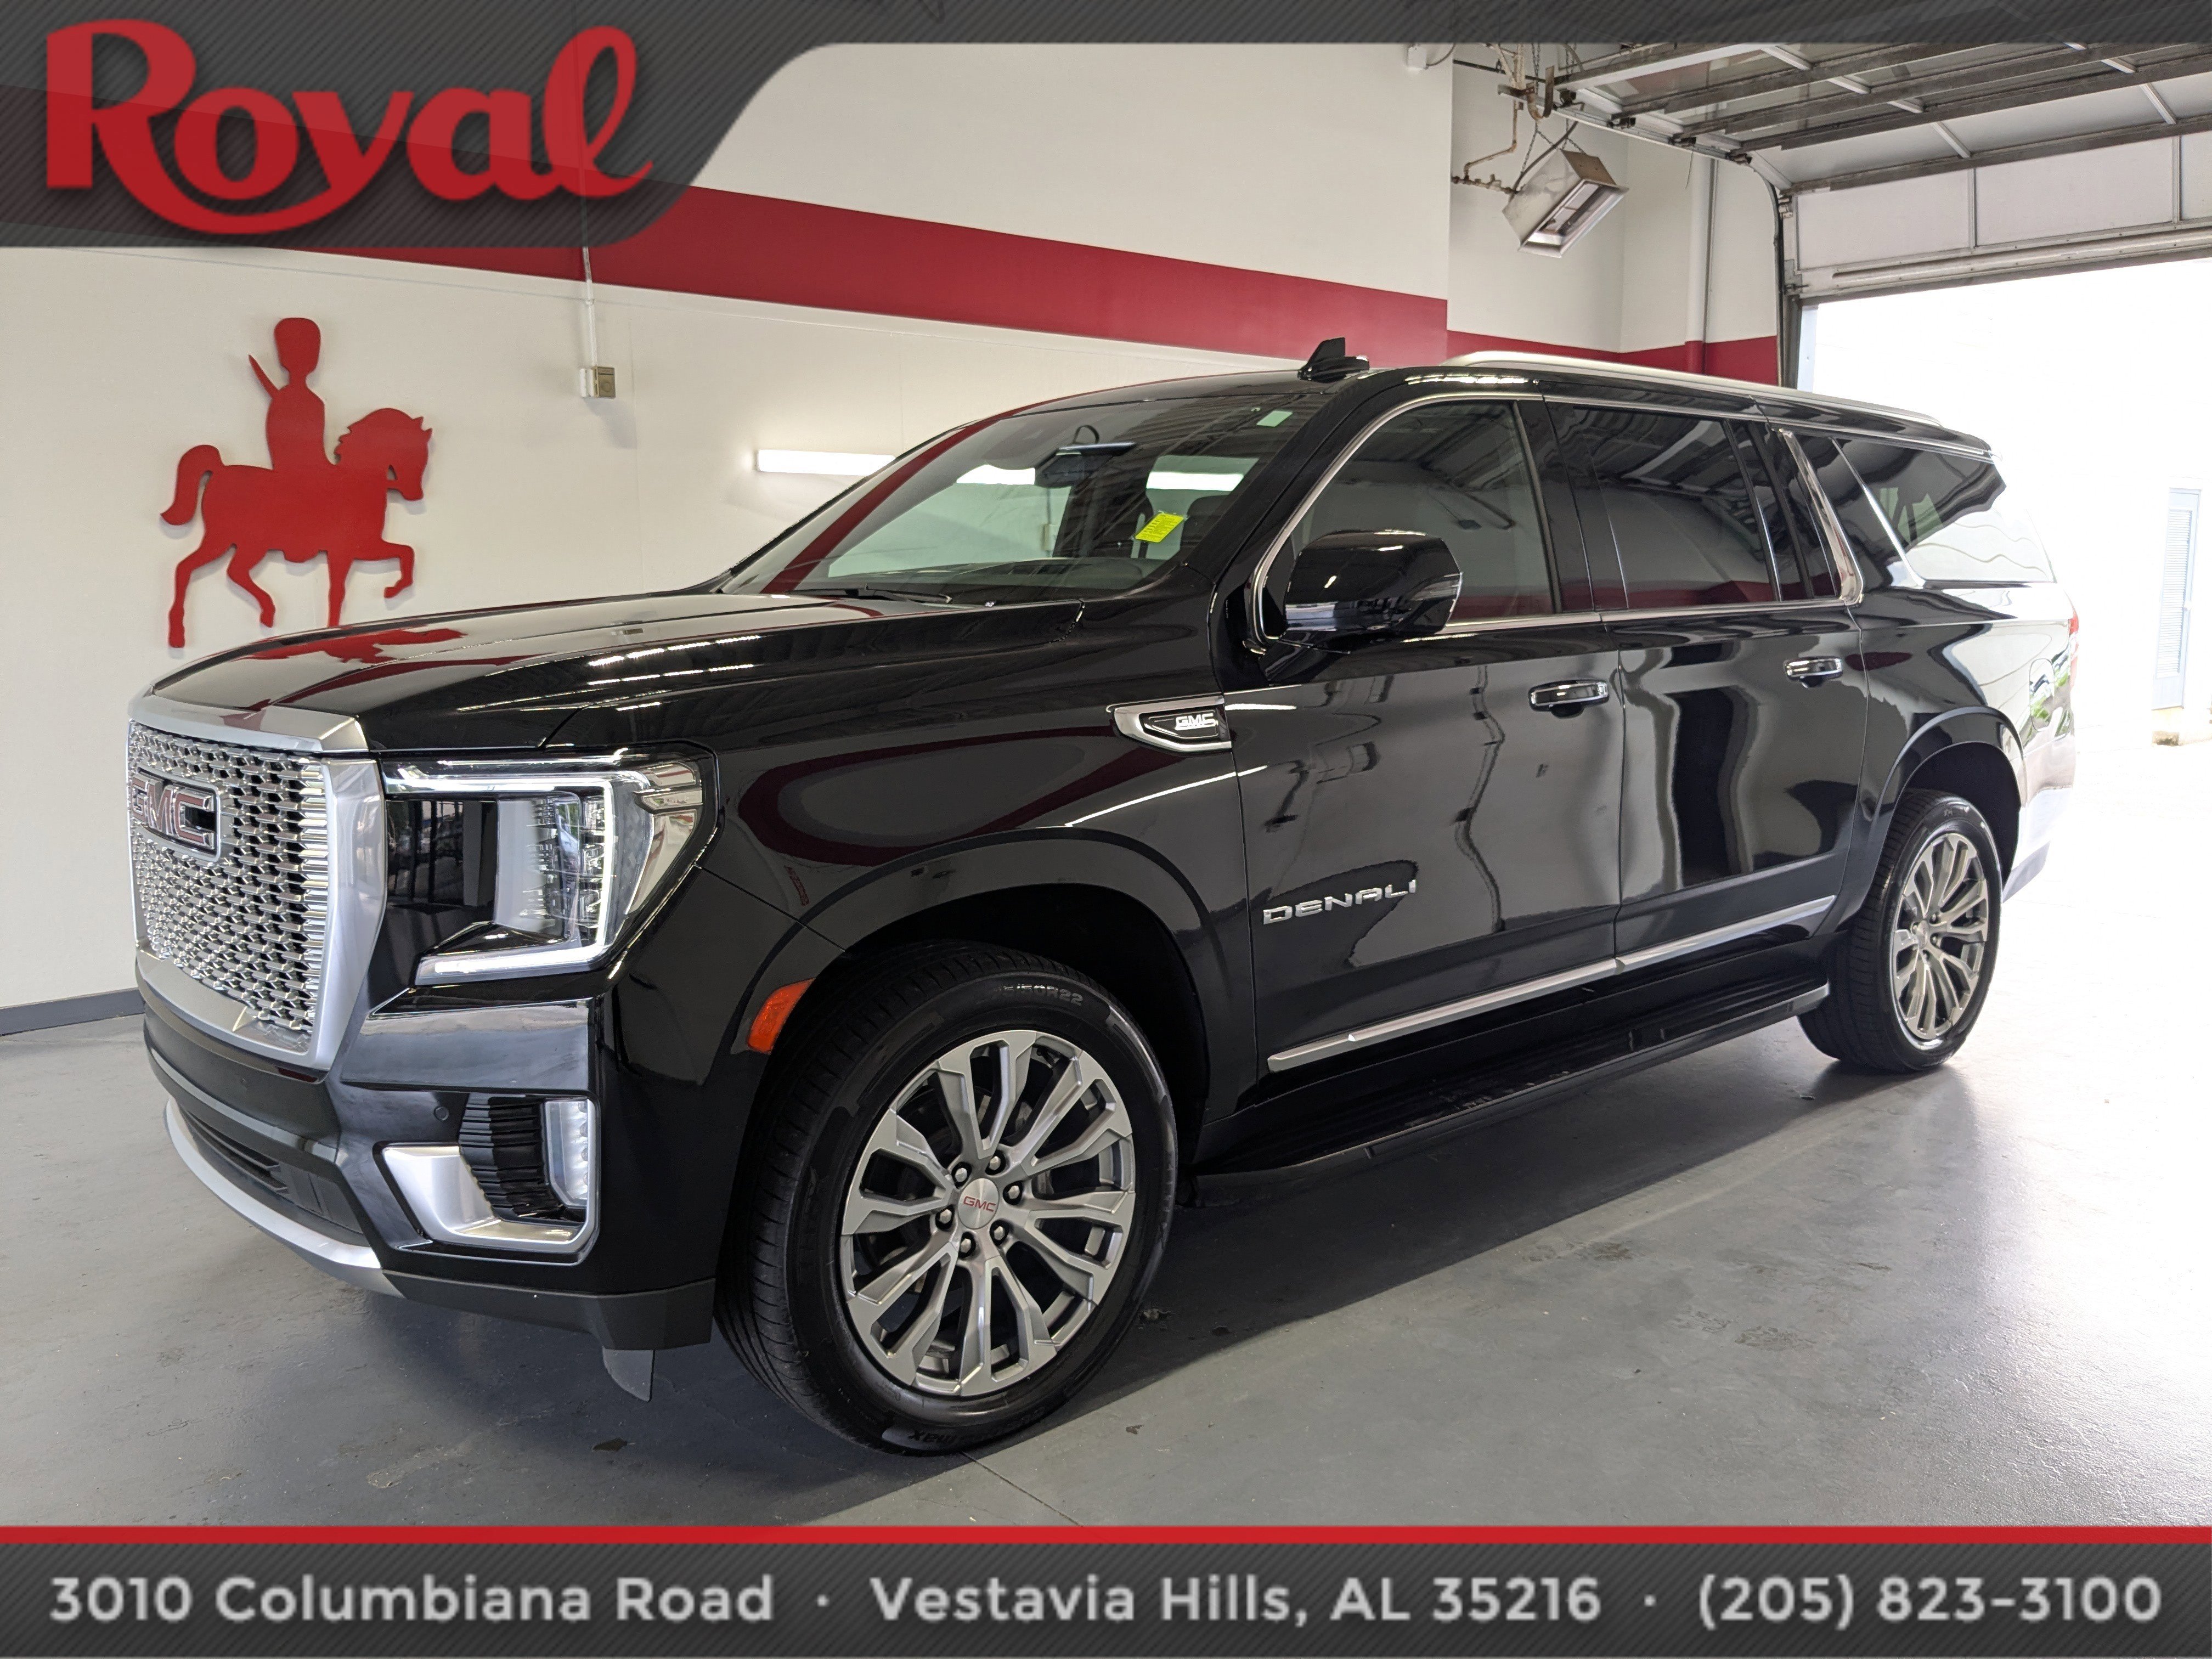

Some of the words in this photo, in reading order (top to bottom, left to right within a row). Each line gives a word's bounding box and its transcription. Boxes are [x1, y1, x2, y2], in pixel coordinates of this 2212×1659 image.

[1175, 713, 1218, 731] GMC
[131, 774, 215, 849] GMC
[1262, 879, 1417, 925] DENALI
[963, 1196, 996, 1212] GMC
